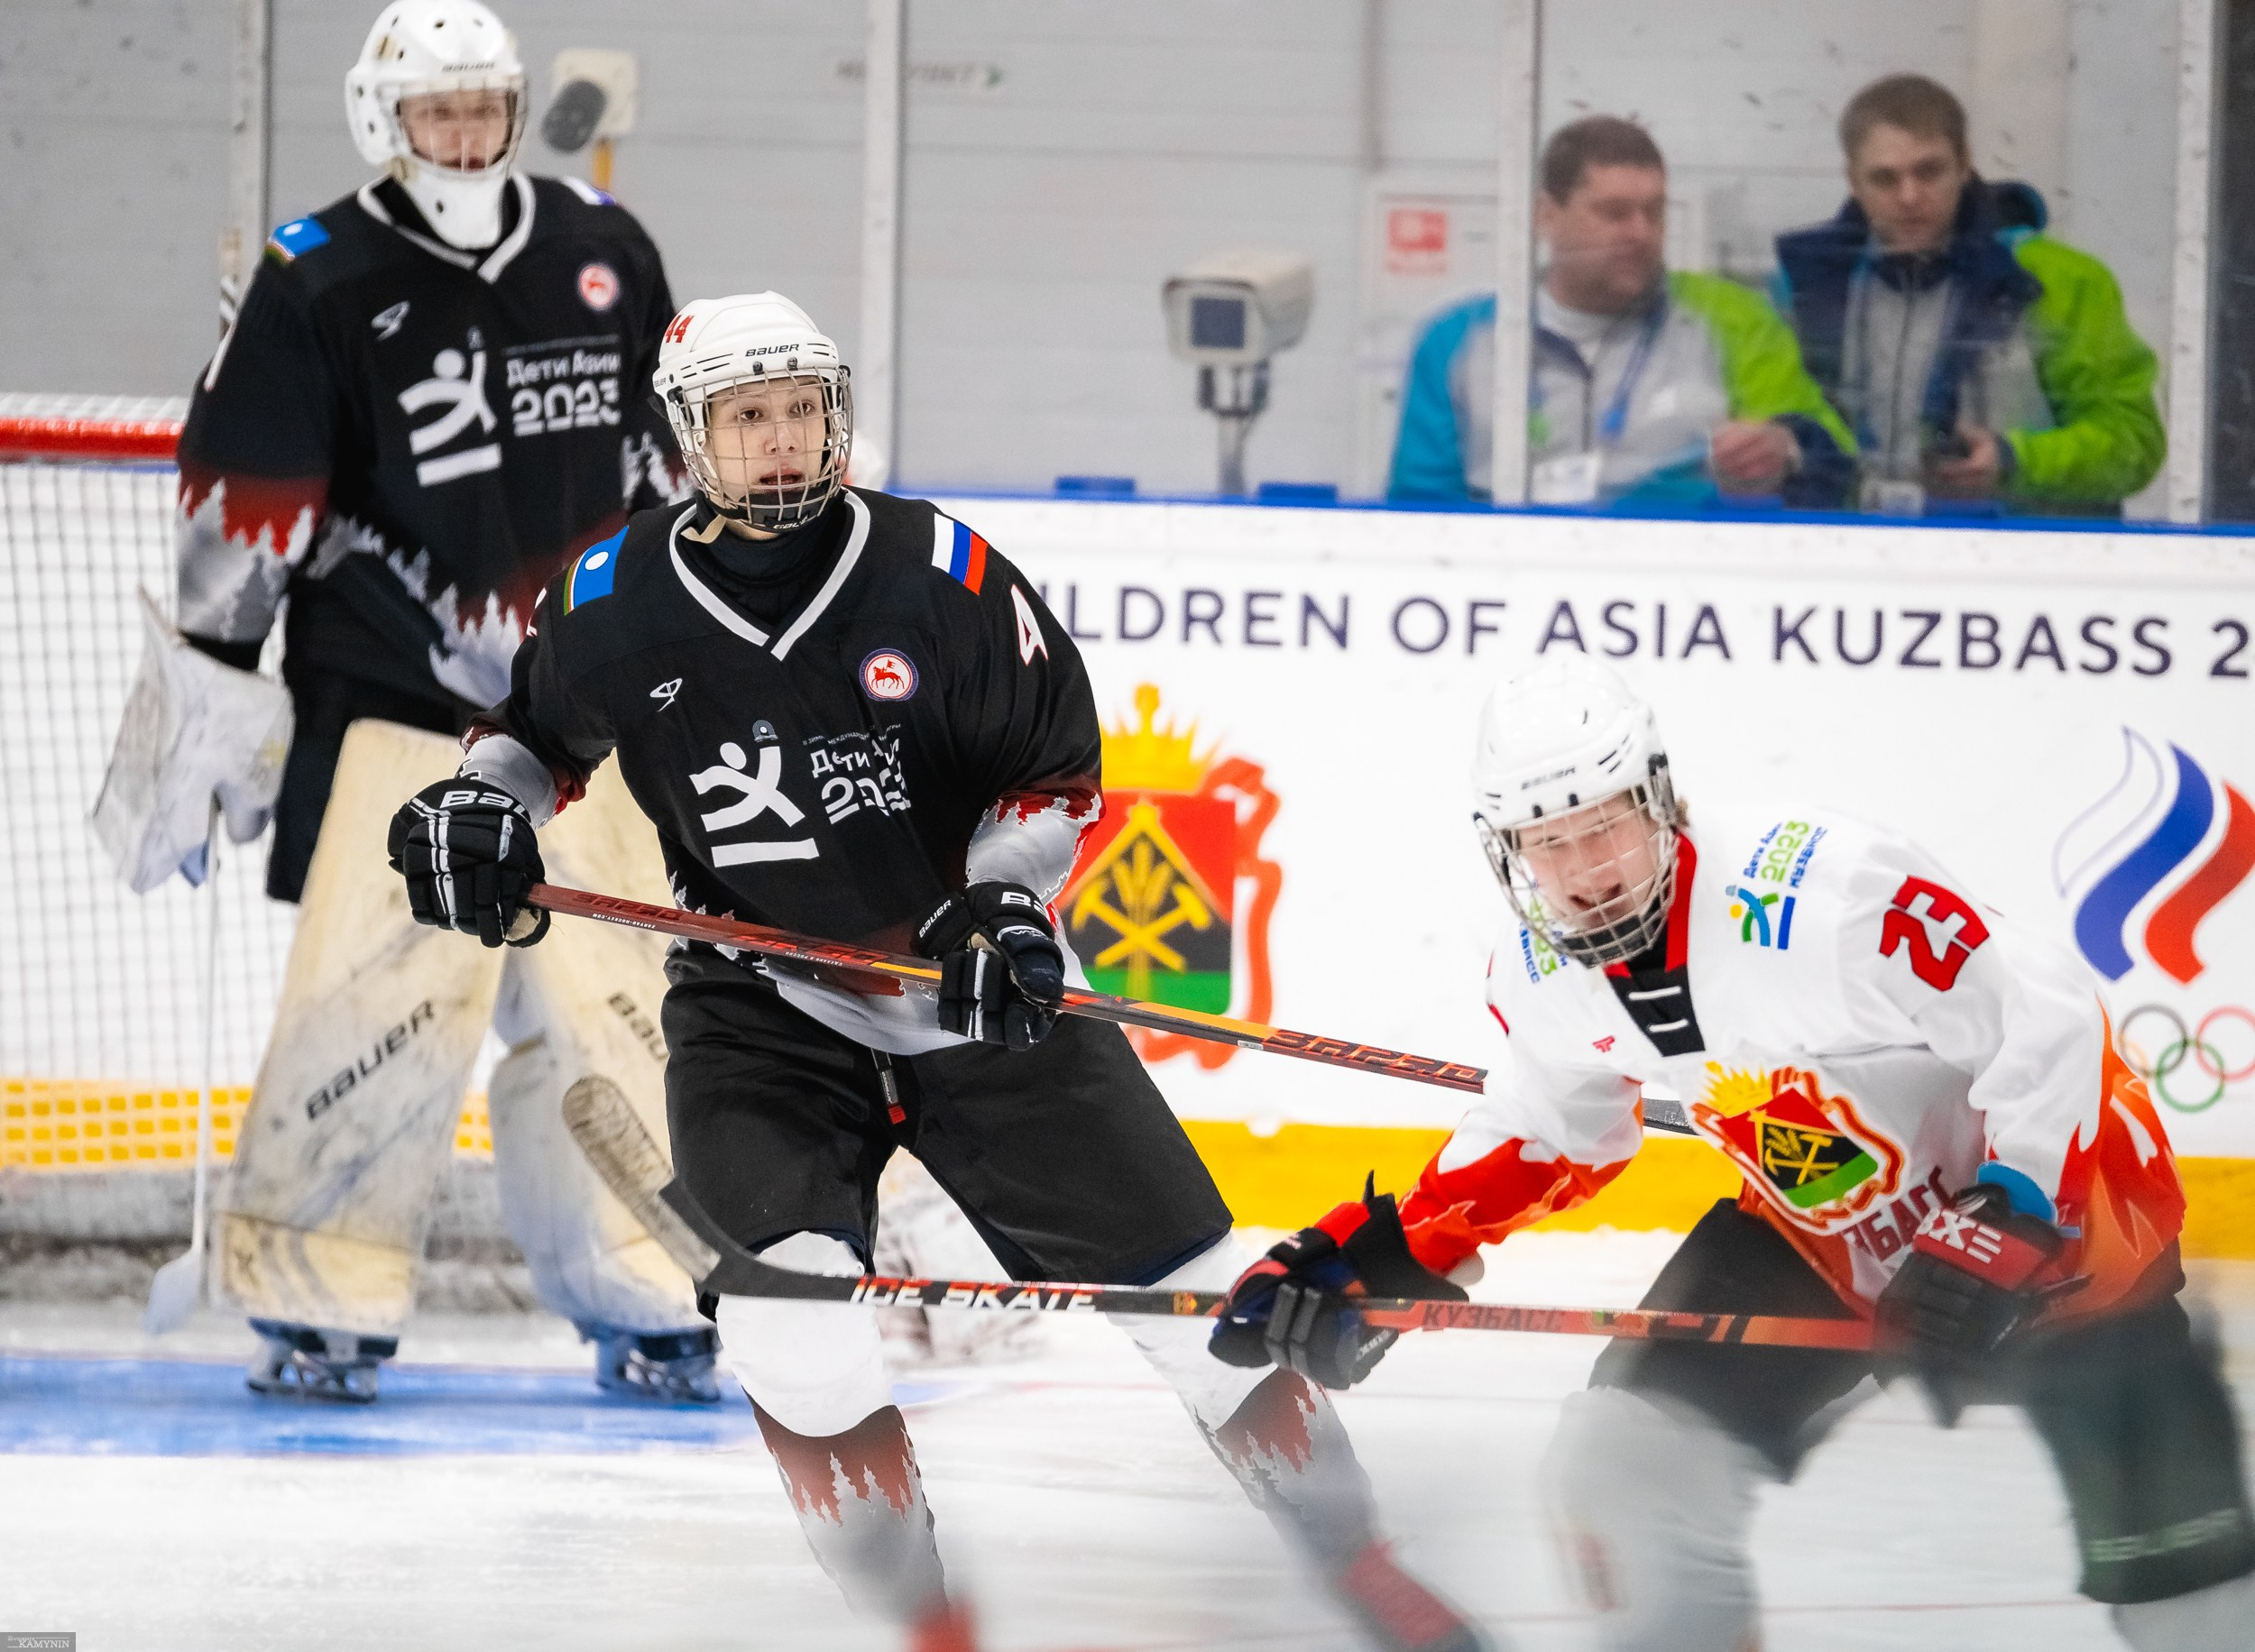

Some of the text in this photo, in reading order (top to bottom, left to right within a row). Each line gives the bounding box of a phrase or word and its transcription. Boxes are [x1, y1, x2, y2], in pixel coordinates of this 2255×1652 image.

[665, 315, 695, 344] 44
[745, 344, 800, 357] BAUER
[511, 378, 621, 437] 2023
[1392, 595, 1506, 656] OF
[1535, 598, 1732, 661] ASIA
[1772, 604, 2174, 677] KUZBASS
[810, 748, 870, 779] Дети
[918, 899, 952, 939] BAUER
[1879, 874, 1991, 993] 23
[1422, 1302, 1567, 1334] КУЗБАСС
